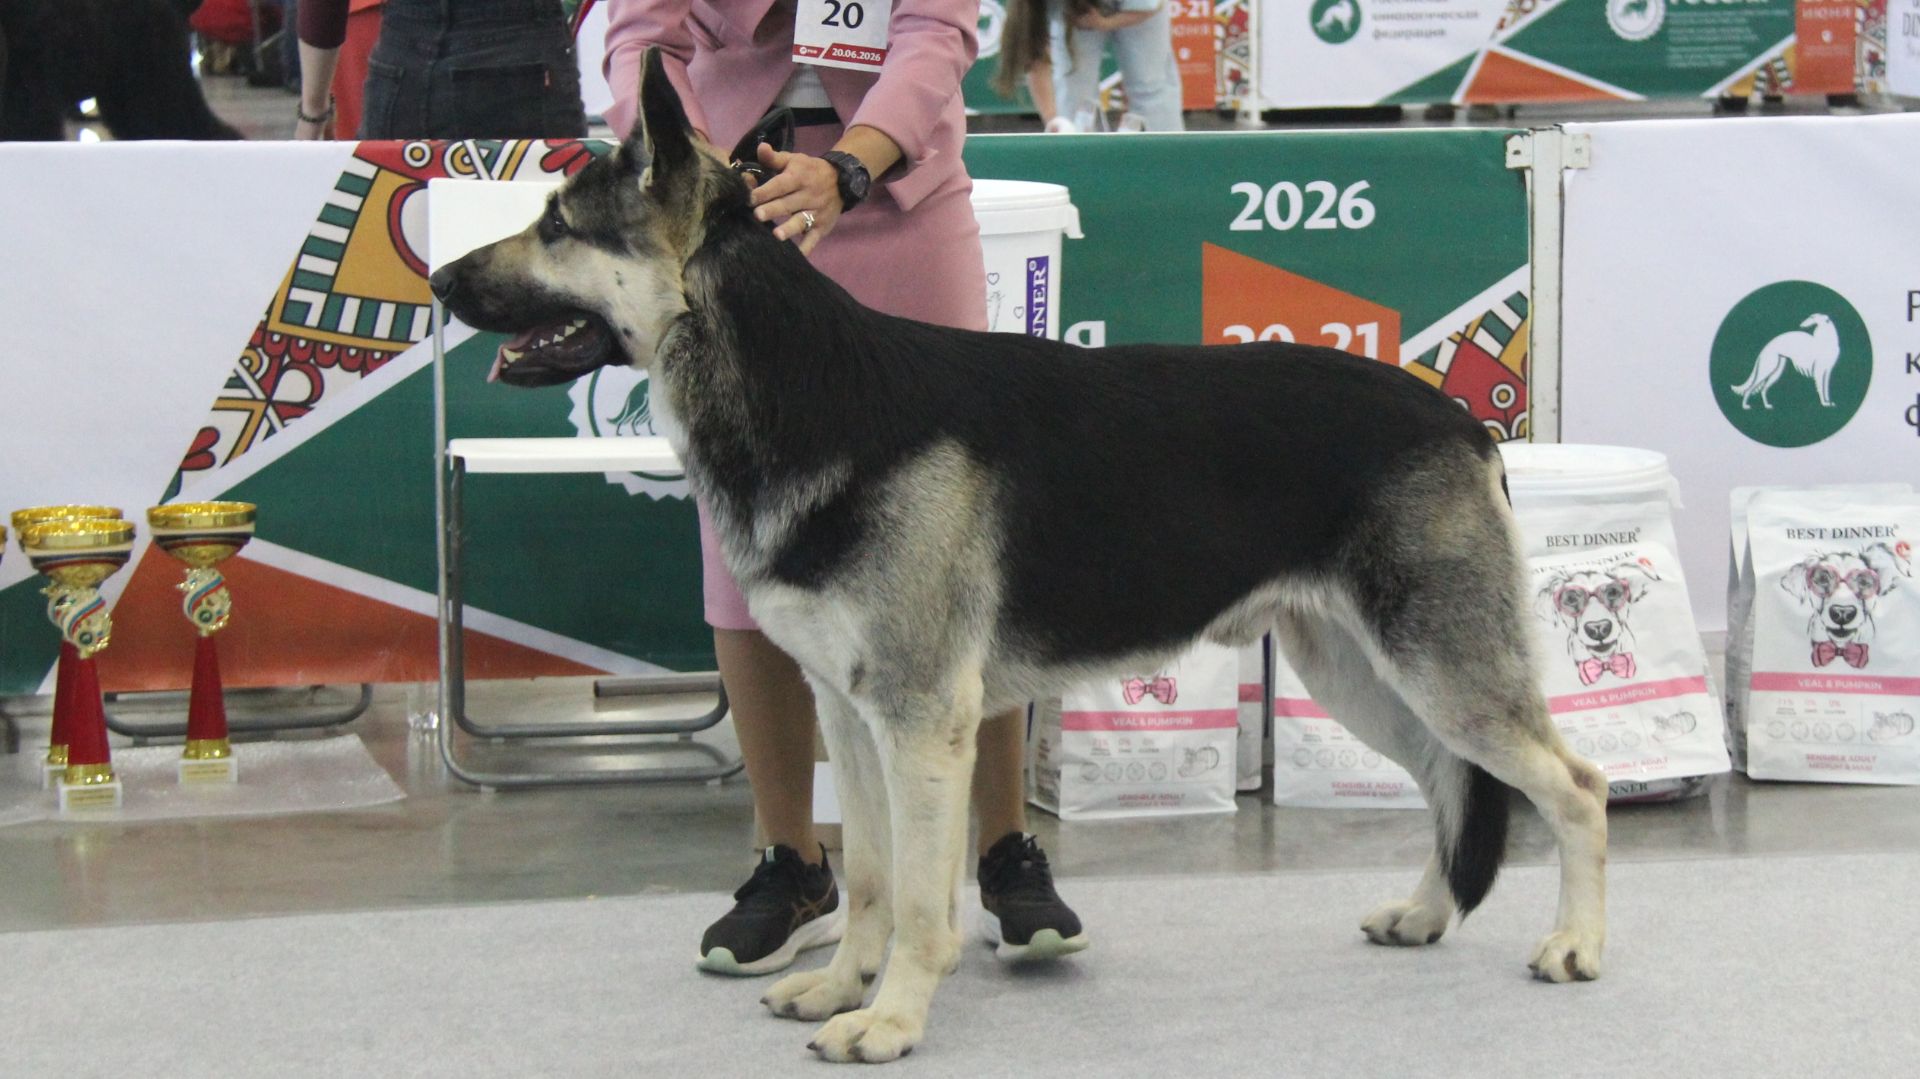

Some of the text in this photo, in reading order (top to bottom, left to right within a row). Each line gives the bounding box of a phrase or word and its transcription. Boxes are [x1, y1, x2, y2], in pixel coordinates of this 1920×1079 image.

[821, 0, 864, 29] 20
[831, 47, 881, 62] 20.06.2026
[1229, 179, 1377, 231] 2026
[1785, 527, 1827, 540] BEST
[1546, 534, 1581, 548] BEST
[1798, 679, 1823, 689] VEAL
[1835, 679, 1882, 690] PUMPKIN
[1571, 696, 1599, 707] VEAL
[1608, 687, 1657, 702] PUMPKIN
[1112, 717, 1142, 727] VEAL
[1147, 716, 1193, 727] PUMPKIN
